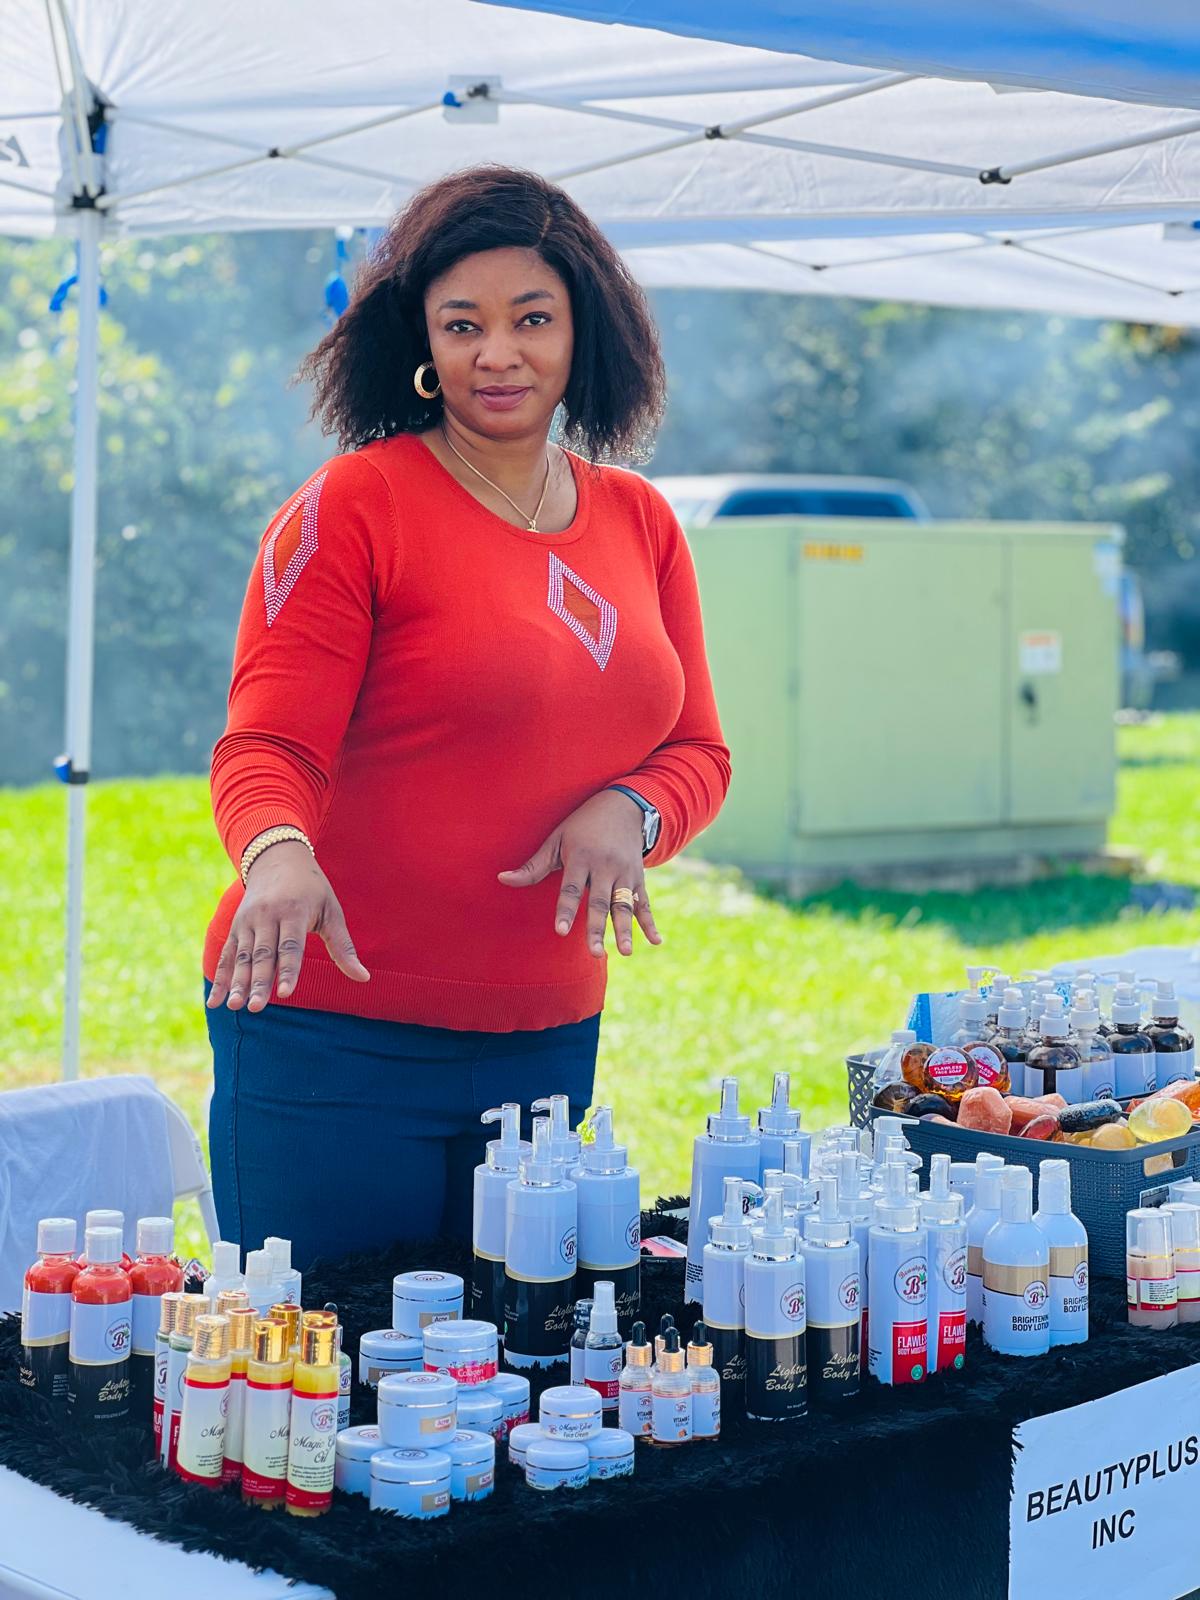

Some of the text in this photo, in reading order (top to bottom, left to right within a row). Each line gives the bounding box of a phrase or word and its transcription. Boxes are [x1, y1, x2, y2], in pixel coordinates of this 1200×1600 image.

[1063, 1305, 1081, 1313] BODY
[434, 1314, 449, 1322] Acne
[822, 1367, 850, 1380] Body
[764, 1379, 794, 1392] Body
[98, 1390, 123, 1402] Body
[1027, 1436, 1198, 1523] BEAUTYPLUS
[1092, 1509, 1136, 1550] INC
